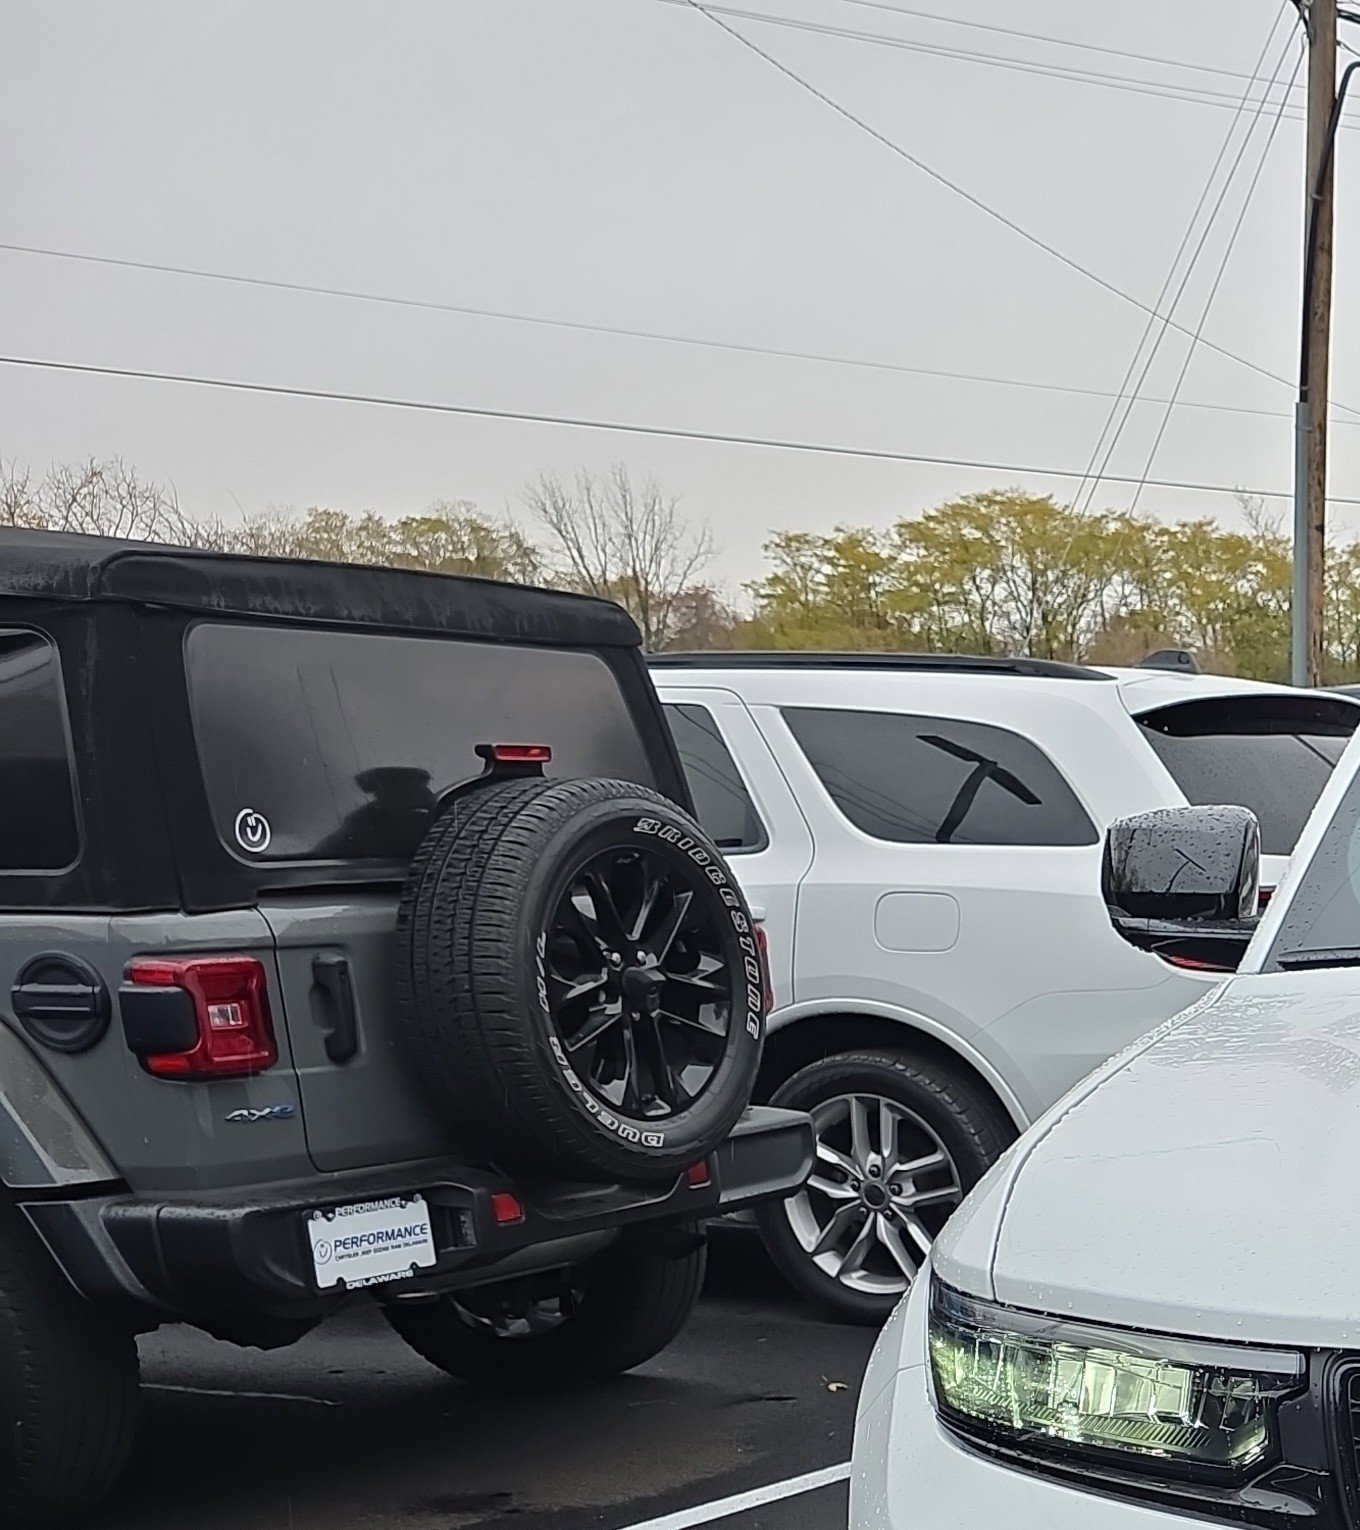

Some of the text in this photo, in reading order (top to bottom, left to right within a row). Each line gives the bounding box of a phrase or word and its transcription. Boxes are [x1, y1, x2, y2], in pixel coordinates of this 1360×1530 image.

[633, 817, 763, 1041] BRIDGESTONE
[549, 1035, 666, 1148] DUELER
[335, 1197, 401, 1217] PERFORMANCE
[333, 1222, 428, 1252] PERFORMANCE
[346, 1269, 414, 1290] DELAWARE
